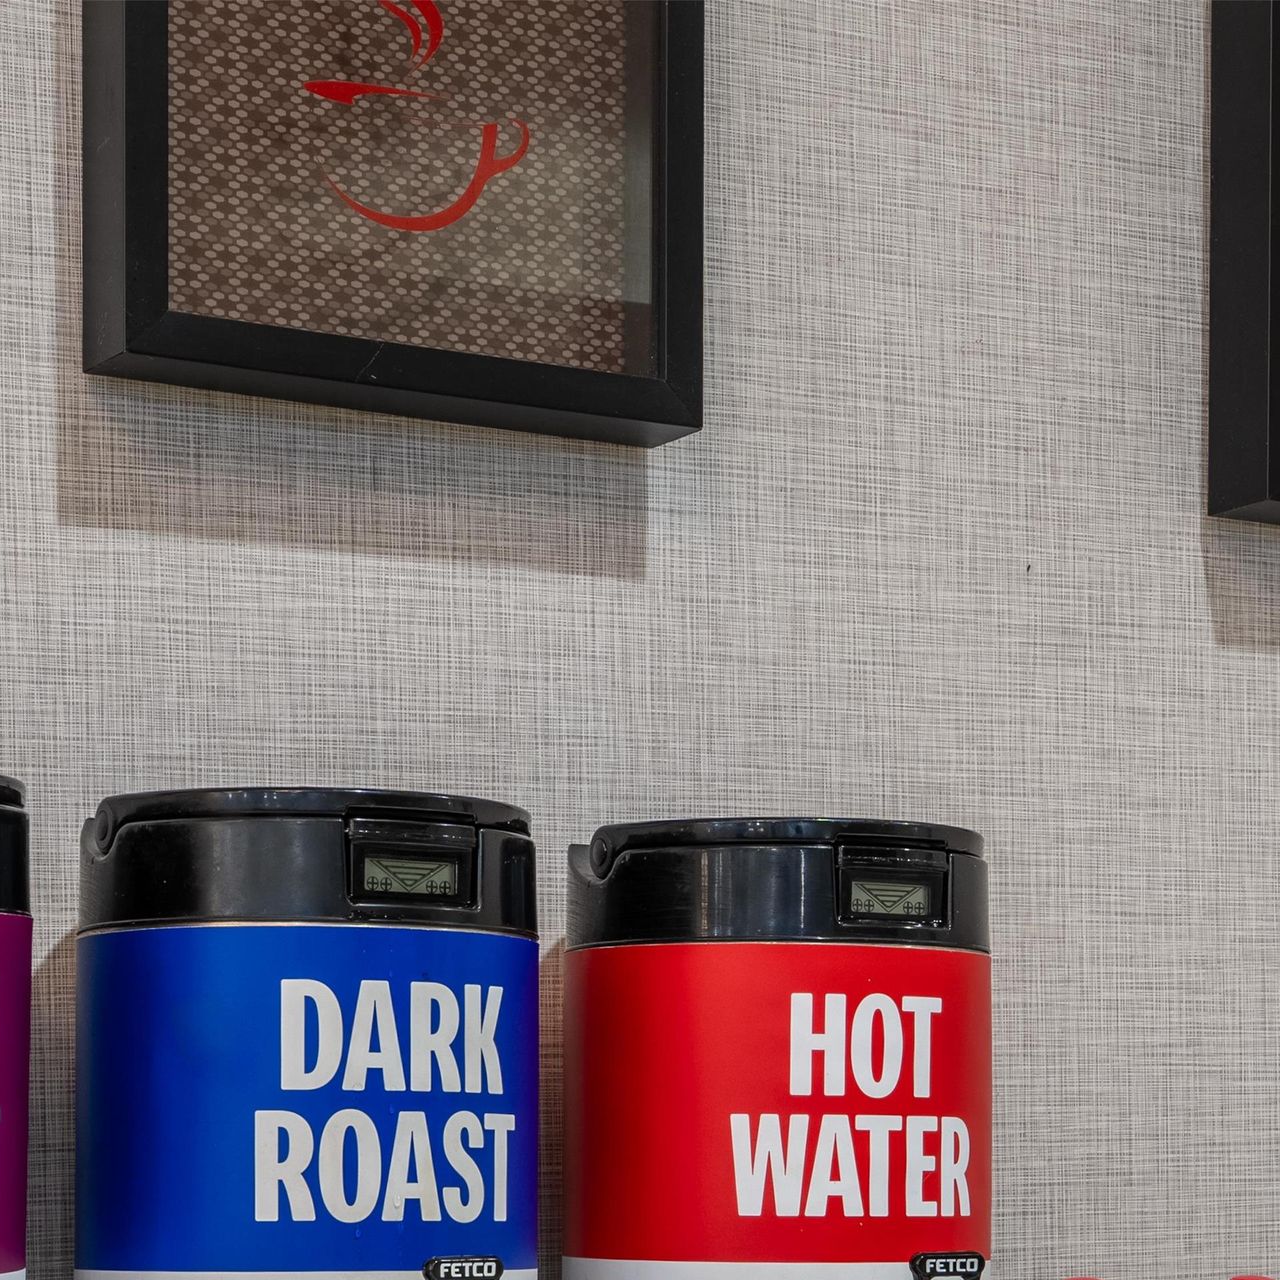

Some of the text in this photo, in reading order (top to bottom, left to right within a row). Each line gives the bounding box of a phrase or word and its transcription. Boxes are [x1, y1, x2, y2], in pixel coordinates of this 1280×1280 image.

[280, 978, 504, 1095] DARK
[789, 992, 943, 1099] HOT
[254, 1108, 516, 1224] ROAST
[729, 1113, 971, 1217] WATER
[440, 1261, 497, 1278] FETCO
[925, 1258, 979, 1273] FETCO
